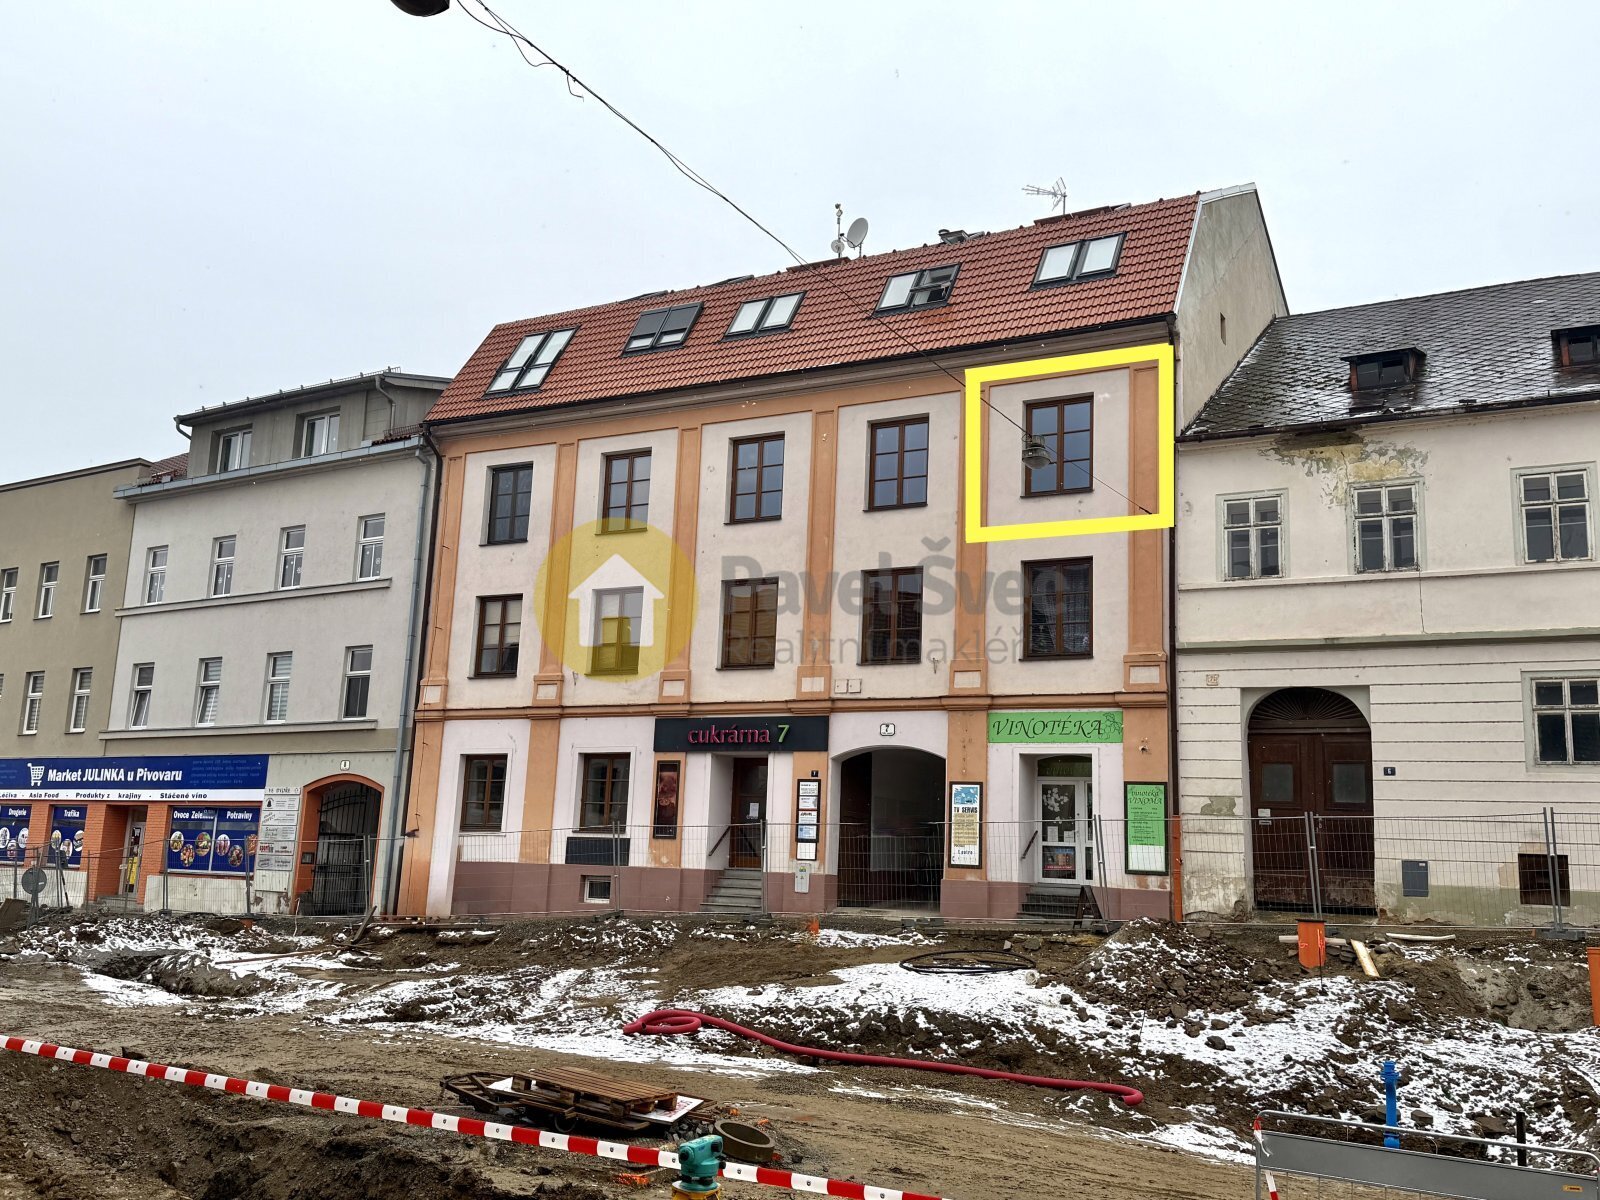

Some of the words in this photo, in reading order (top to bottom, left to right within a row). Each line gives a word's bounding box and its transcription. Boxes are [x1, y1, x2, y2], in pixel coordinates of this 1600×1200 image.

[992, 715, 1105, 739] VINOTÉKA
[687, 724, 771, 744] cukrárna
[777, 724, 790, 743] 7
[47, 769, 82, 782] Market
[82, 768, 125, 781] JULINKA
[127, 771, 134, 781] u
[136, 768, 182, 781] Pivovaru
[75, 792, 105, 800] Produkty
[118, 792, 141, 800] krajiny
[160, 791, 189, 799] Stáčené
[8, 807, 27, 817] Drogerie
[63, 809, 80, 817] Trafika
[173, 810, 190, 819] Ovoce
[961, 806, 978, 814] SERVIS
[226, 810, 253, 821] Potraviny
